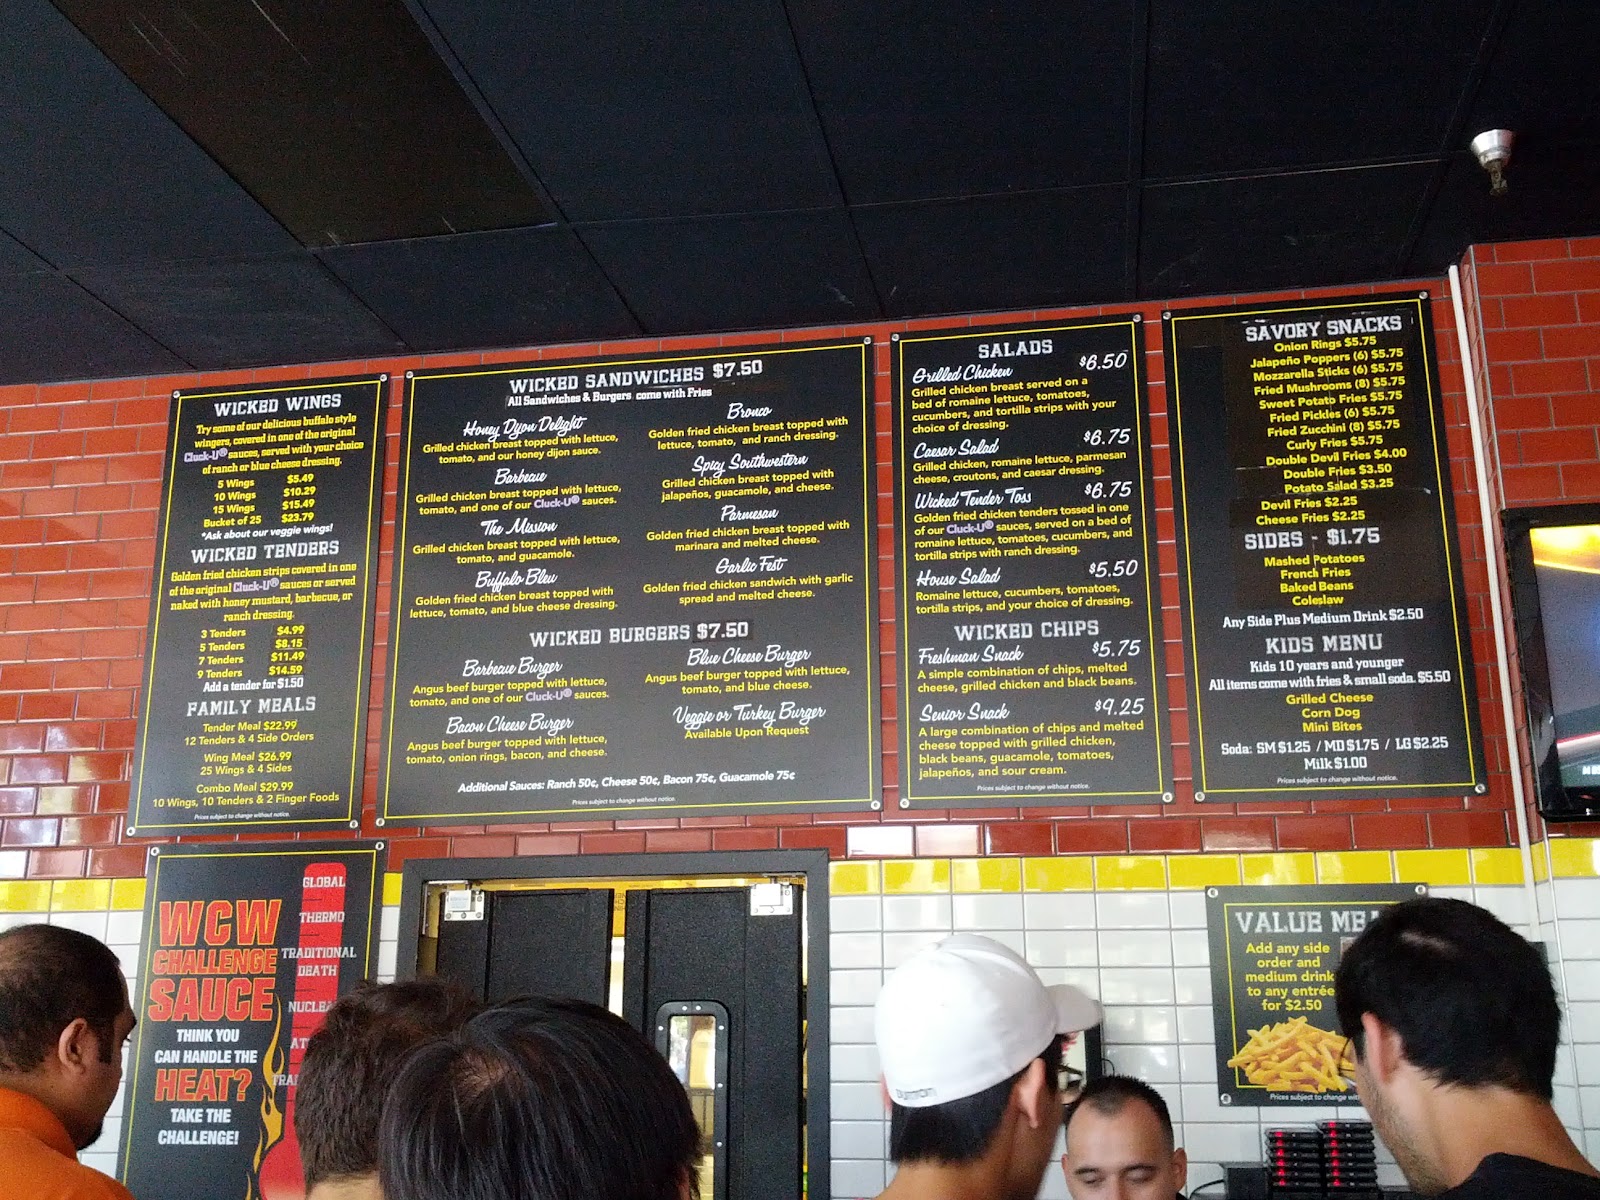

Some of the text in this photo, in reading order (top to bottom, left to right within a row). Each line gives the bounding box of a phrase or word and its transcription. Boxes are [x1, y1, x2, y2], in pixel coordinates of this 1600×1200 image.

[1245, 315, 1402, 342] SAVORY SNACKS
[978, 339, 1053, 359] SALADS
[1274, 335, 1377, 352] Onion Rings $5.75
[912, 352, 1127, 384] Grilled Chicken $6.50
[509, 359, 763, 394] WICKED SANDWICHES $7.50
[214, 393, 341, 417] WICKED WINGS
[727, 402, 773, 419] Bronco
[1270, 405, 1395, 423] Fried Pickles (6) $5.75
[913, 428, 1131, 459] Caesar Salad $6.75
[1286, 435, 1383, 451] Curly Fries $5.75
[692, 452, 809, 478] Spicy Southwestern
[217, 473, 314, 489] 5 Wings $5.49
[214, 486, 316, 503] 10 Wings $10.29
[915, 481, 1132, 509] Wicked Tender Toss $6.75
[203, 512, 314, 528] Bucket of 25 $23.79
[721, 505, 779, 521] Parmesan
[480, 519, 504, 536] The
[1245, 531, 1303, 550] SIDES
[1327, 527, 1380, 546] $1.75
[191, 540, 339, 563] WICKED TENDERS
[715, 555, 788, 574] Garlic Fest
[1264, 554, 1365, 567] Mashed Potatoes
[916, 559, 1138, 586] House Salad $5.50
[1280, 567, 1351, 579] French Fries
[475, 571, 525, 593] Buffalo
[1280, 581, 1354, 593] Baked Beans
[1292, 594, 1344, 606] Coleslaw
[201, 625, 305, 639] 3 Tenders $4.99
[529, 622, 748, 647] WICKED BURGERS $7.50
[954, 620, 1099, 641] WICKED CHIPS
[200, 638, 303, 652] 5 Tenders $8.15
[1265, 633, 1382, 654] KIDS MENU
[199, 651, 305, 665] 7 Tenders $11.49
[687, 644, 811, 668] Blue Cheese Burger
[918, 639, 1141, 665] Freshman Snack $5.75
[518, 656, 563, 680] Burger
[186, 696, 316, 717] FAMILY MEALS
[1286, 692, 1374, 705] Grilled Cheese
[672, 701, 826, 730] Veggie or Turkey Burger
[919, 698, 1145, 722] Senior Snack $9.25
[1302, 707, 1360, 719] Corn Dog
[203, 719, 298, 732] Tender Meal $22.99
[684, 726, 809, 740] Available Upon Request
[204, 751, 292, 764] Wing Meal $26.99
[1304, 756, 1367, 770] Milk $1.00
[196, 781, 294, 793] Combo Meal $29.99
[303, 876, 346, 888] GLOBAL
[159, 899, 282, 946] WCW
[299, 911, 345, 924] THERMO
[1235, 911, 1322, 933] VALUE
[281, 946, 357, 960] TRADITIONAL
[1246, 941, 1330, 956] Add any side
[152, 949, 277, 975] CHALLENGE
[1257, 956, 1320, 968] order and
[297, 964, 337, 977] DEATH
[1245, 970, 1334, 982] medium drink
[148, 977, 276, 1022] SAUCE
[1246, 985, 1335, 999] to any entrée
[1261, 998, 1322, 1011] for $2.50
[176, 1029, 240, 1042] THINK YOU
[155, 1050, 258, 1063] CAN HANDLE THE
[155, 1068, 253, 1102] HEAT?
[1290, 1093, 1313, 1102] subject
[1323, 1093, 1347, 1102] change
[171, 1108, 231, 1123] TAKE THE
[158, 1130, 239, 1145] CHALLENGE!
